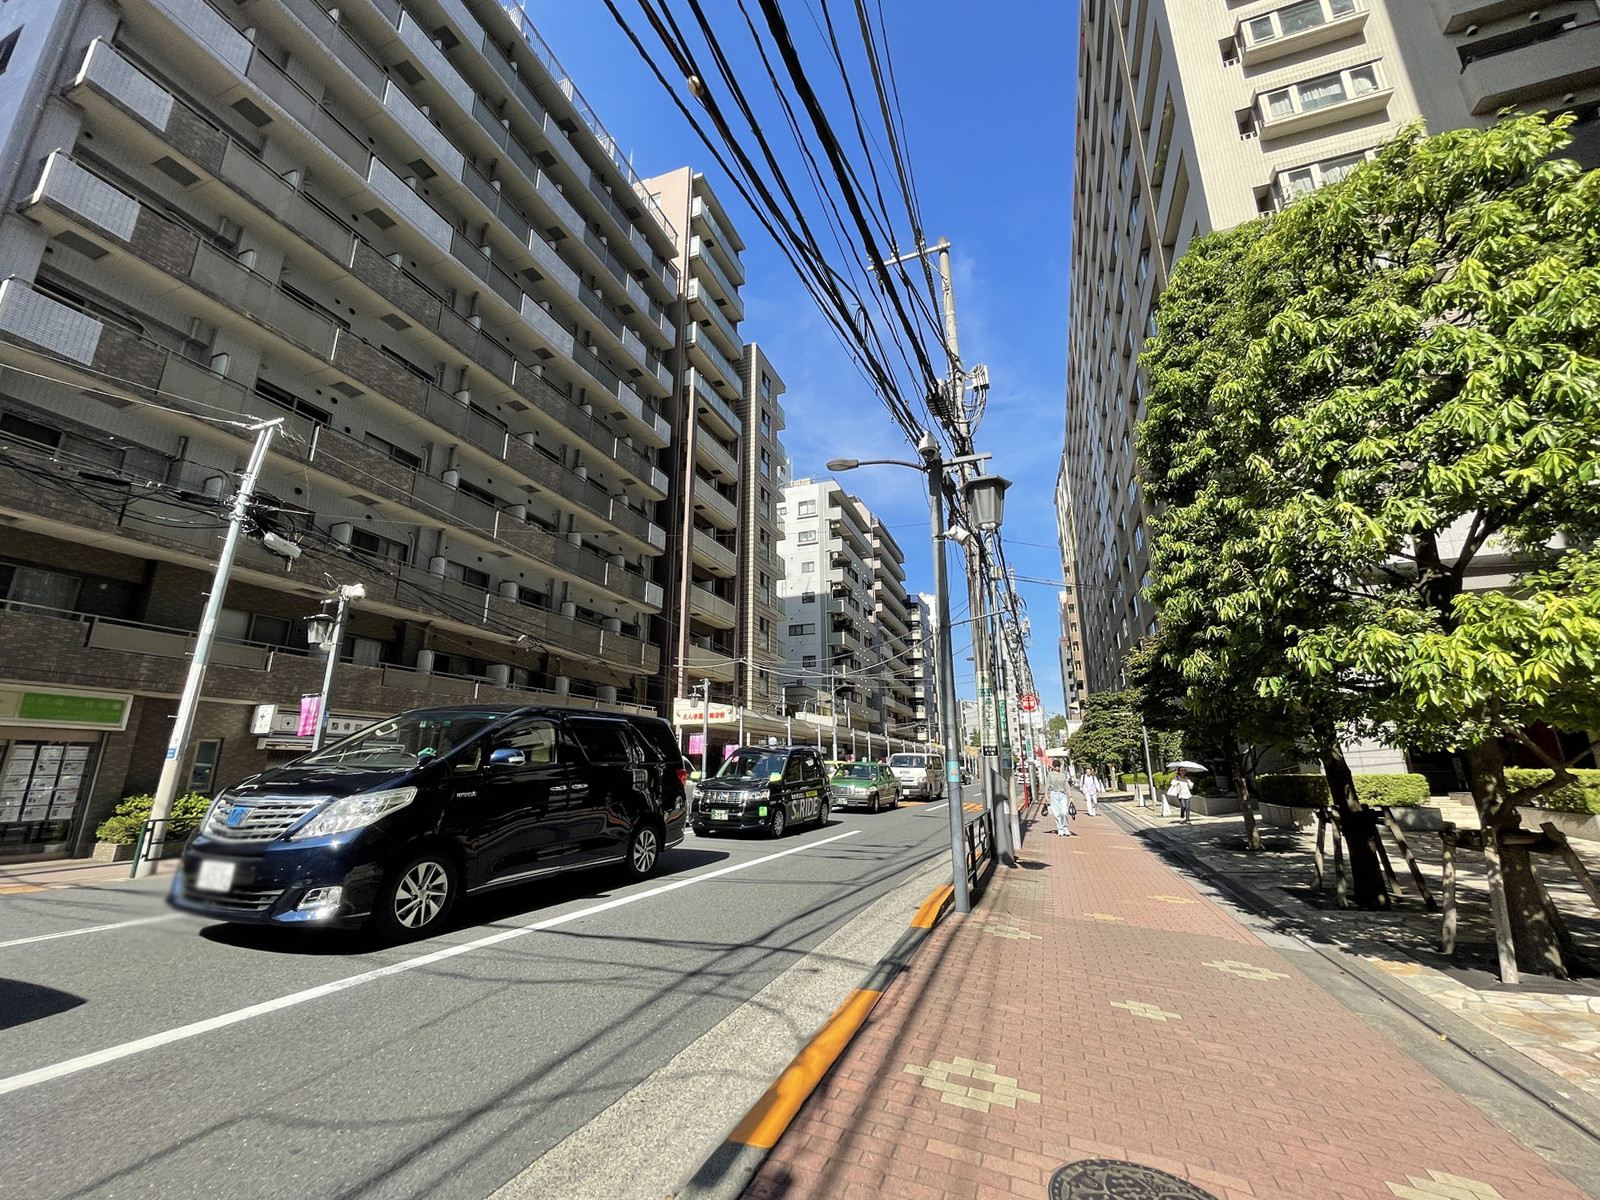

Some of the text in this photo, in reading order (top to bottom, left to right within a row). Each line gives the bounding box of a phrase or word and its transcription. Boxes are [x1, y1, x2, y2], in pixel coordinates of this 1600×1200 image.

[682, 711, 725, 720] えんま通商店街
